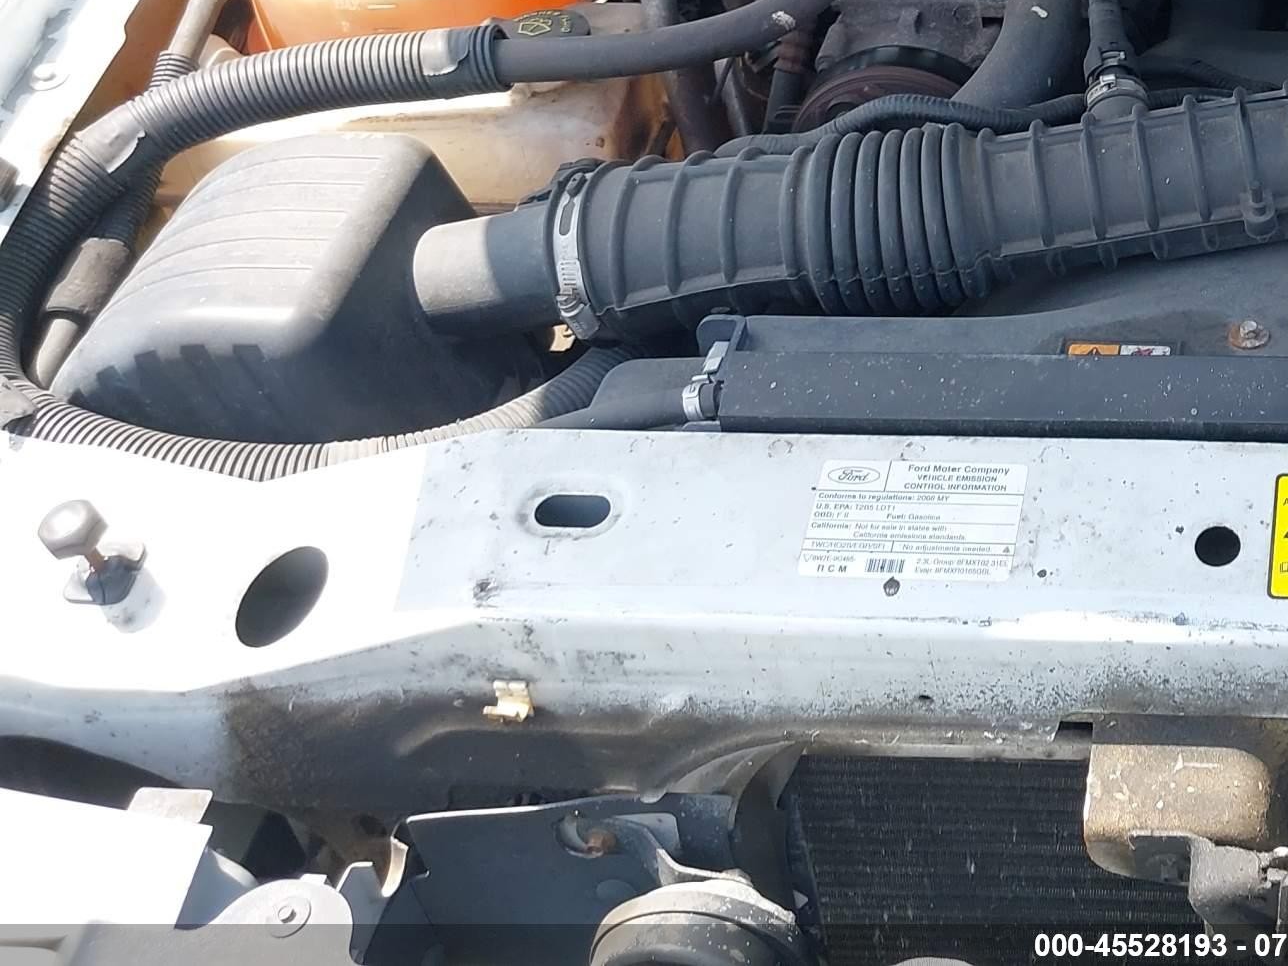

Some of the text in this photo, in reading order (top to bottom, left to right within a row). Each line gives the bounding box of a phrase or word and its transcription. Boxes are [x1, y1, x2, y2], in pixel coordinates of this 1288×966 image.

[837, 468, 871, 481] Ford
[907, 463, 930, 472] Ford
[963, 465, 1010, 475] Company
[916, 473, 953, 481] VEHICLE
[903, 482, 1007, 492] CONTROL INFORMATION
